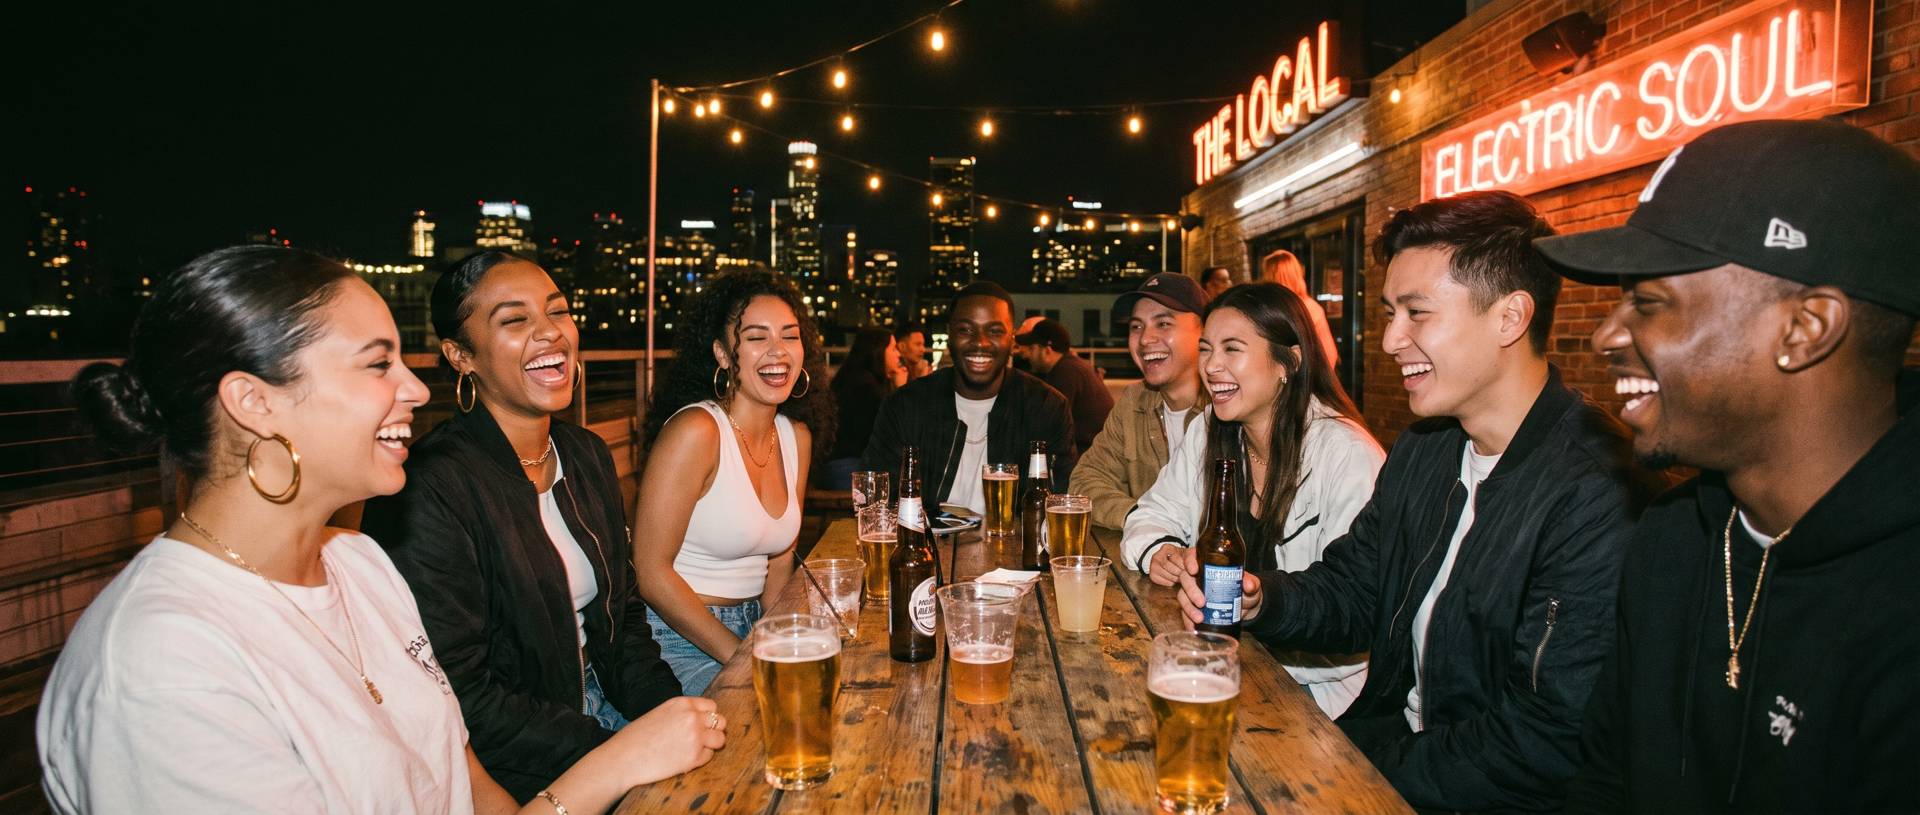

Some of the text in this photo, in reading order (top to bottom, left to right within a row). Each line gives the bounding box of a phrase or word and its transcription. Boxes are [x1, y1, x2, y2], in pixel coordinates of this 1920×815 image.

[1193, 21, 1341, 185] THE LOCAL
[1435, 82, 1622, 198] ELECTRIC
[1637, 9, 1833, 140] SOUL
